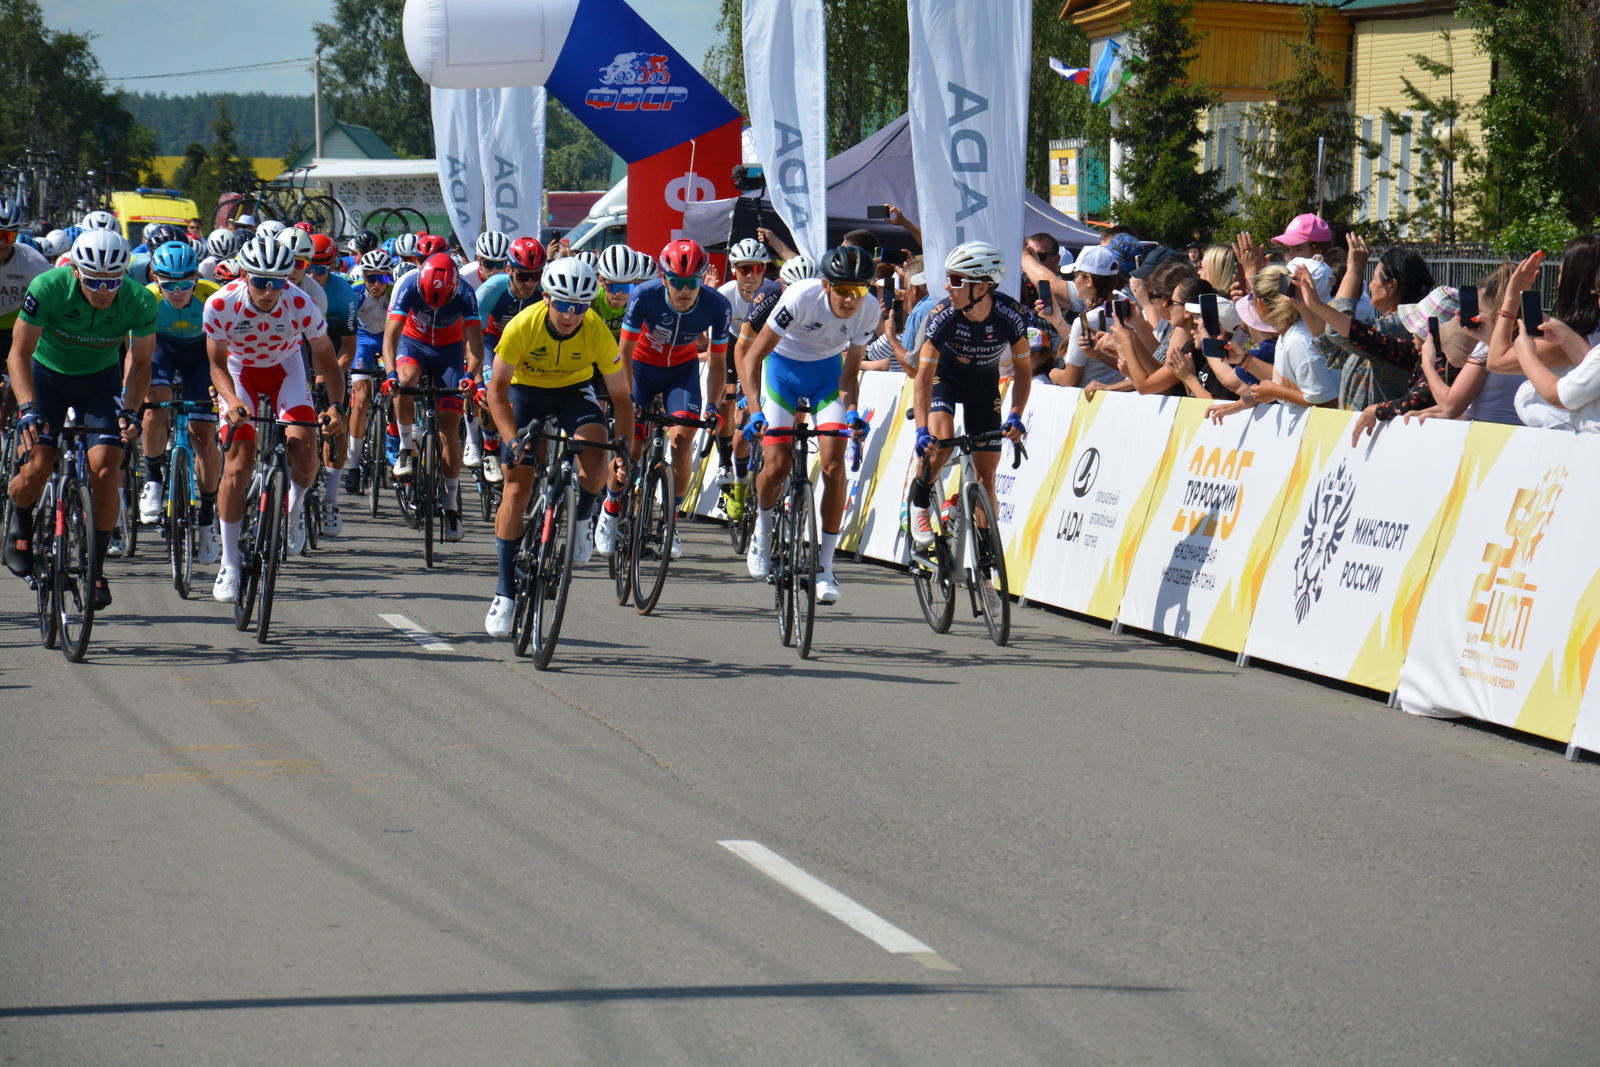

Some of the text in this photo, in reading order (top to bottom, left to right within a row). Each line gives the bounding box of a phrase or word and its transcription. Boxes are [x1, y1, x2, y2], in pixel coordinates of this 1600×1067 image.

[585, 86, 688, 112] ФВСР
[1183, 479, 1239, 512] ТУР РОССИИ
[1056, 509, 1084, 543] LADA
[1351, 517, 1409, 551] МИНСПОРТ
[1339, 560, 1384, 594] РОССИИ
[1480, 589, 1534, 652] ЦСП
